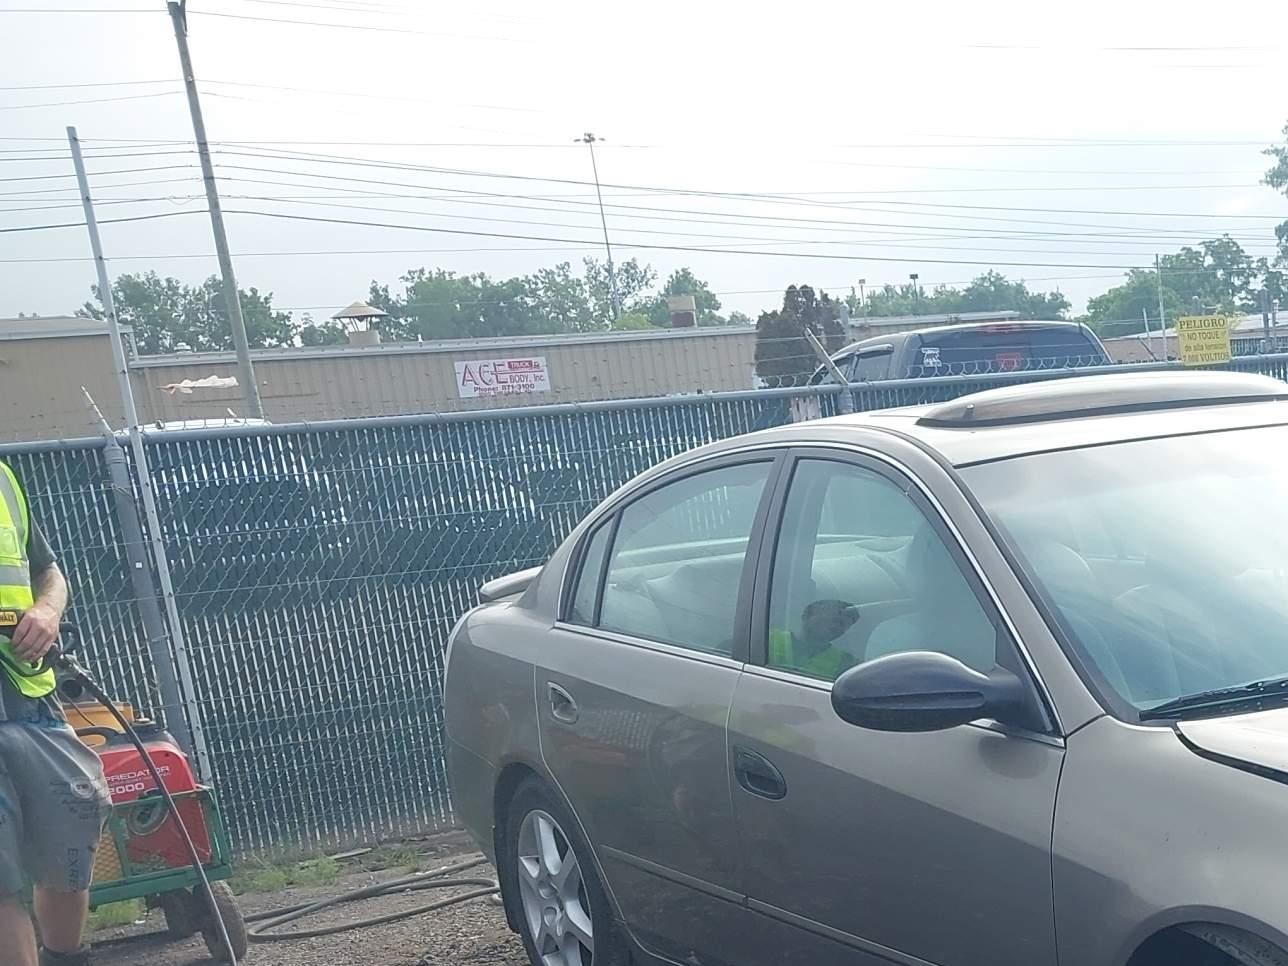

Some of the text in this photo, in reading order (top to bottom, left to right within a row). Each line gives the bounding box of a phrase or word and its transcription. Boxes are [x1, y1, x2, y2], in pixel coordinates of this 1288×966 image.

[1179, 318, 1225, 329] PELIGRO
[1187, 330, 1220, 341] NO TOQUE
[1199, 352, 1230, 362] VOLTIOS
[461, 361, 508, 387] ACE
[509, 361, 531, 369] TRUCK
